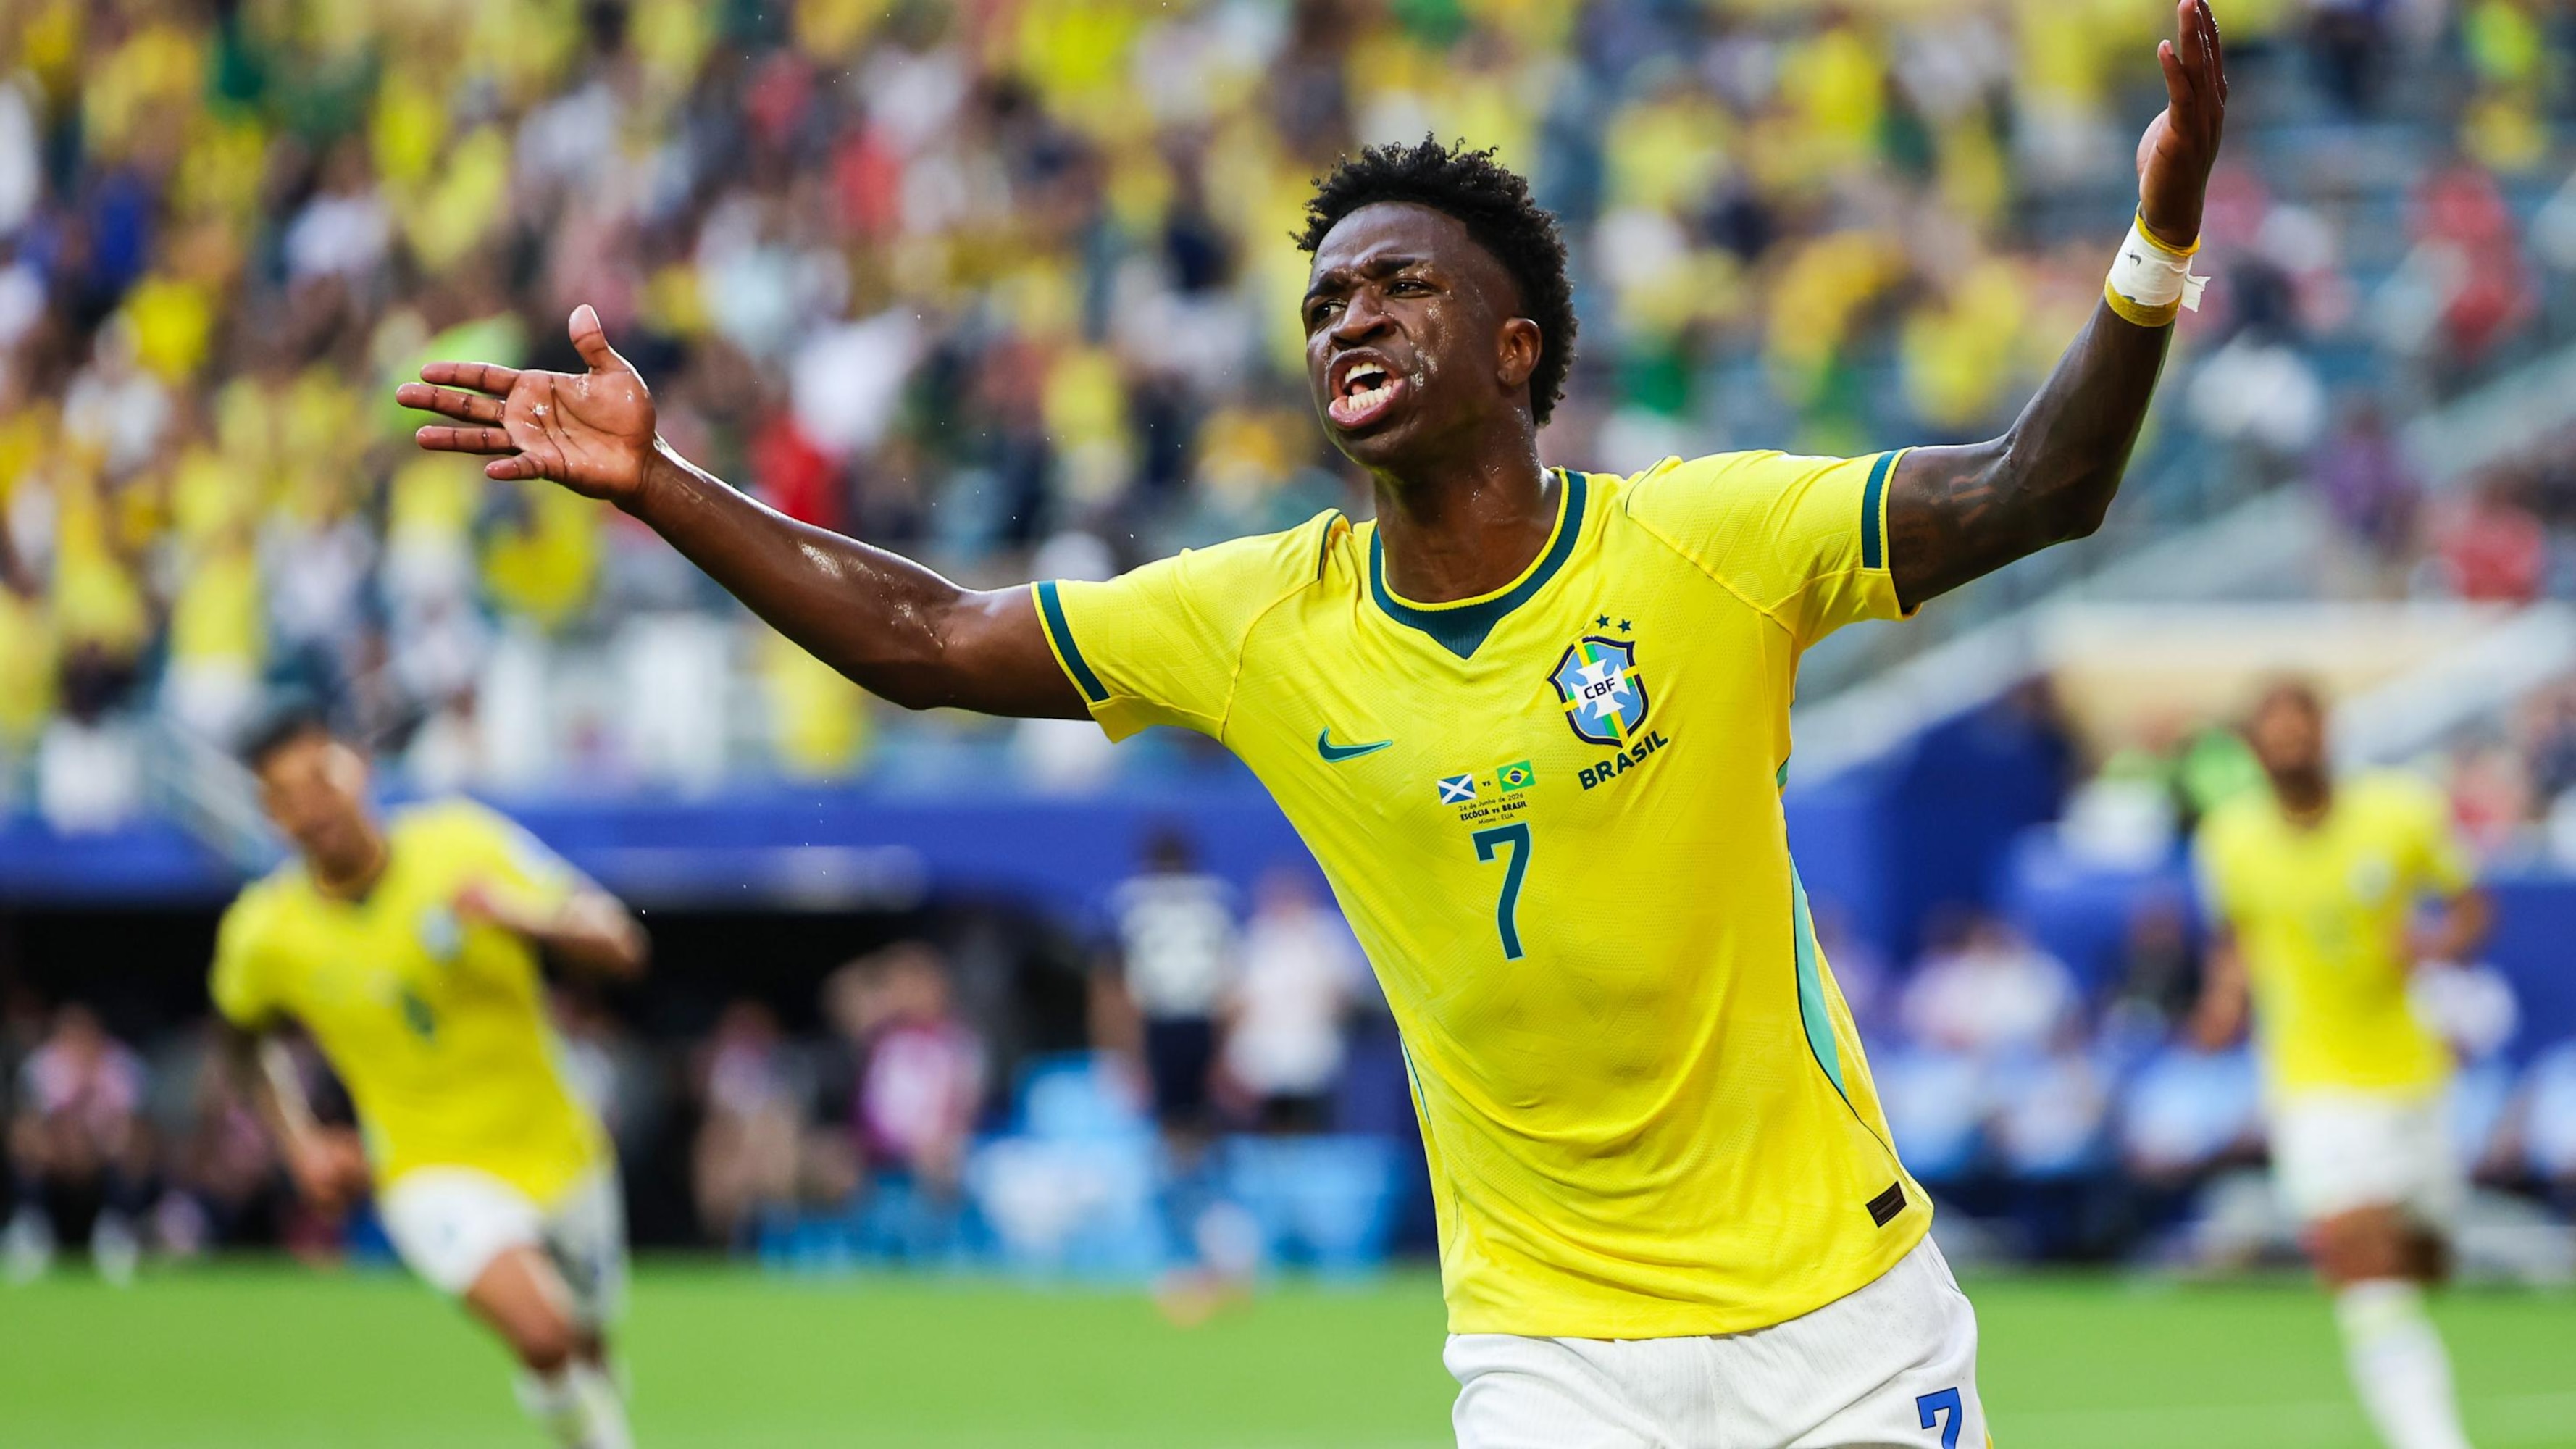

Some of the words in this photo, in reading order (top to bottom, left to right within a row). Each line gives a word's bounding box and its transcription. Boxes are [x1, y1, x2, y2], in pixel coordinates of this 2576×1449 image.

[1584, 677, 1616, 700] CBF
[1578, 730, 1669, 790] BRASIL
[1460, 808, 1489, 821] ESCÓCIA
[1502, 801, 1527, 811] BRASIL
[1471, 821, 1533, 962] 7
[1916, 1387, 1962, 1449] 7
